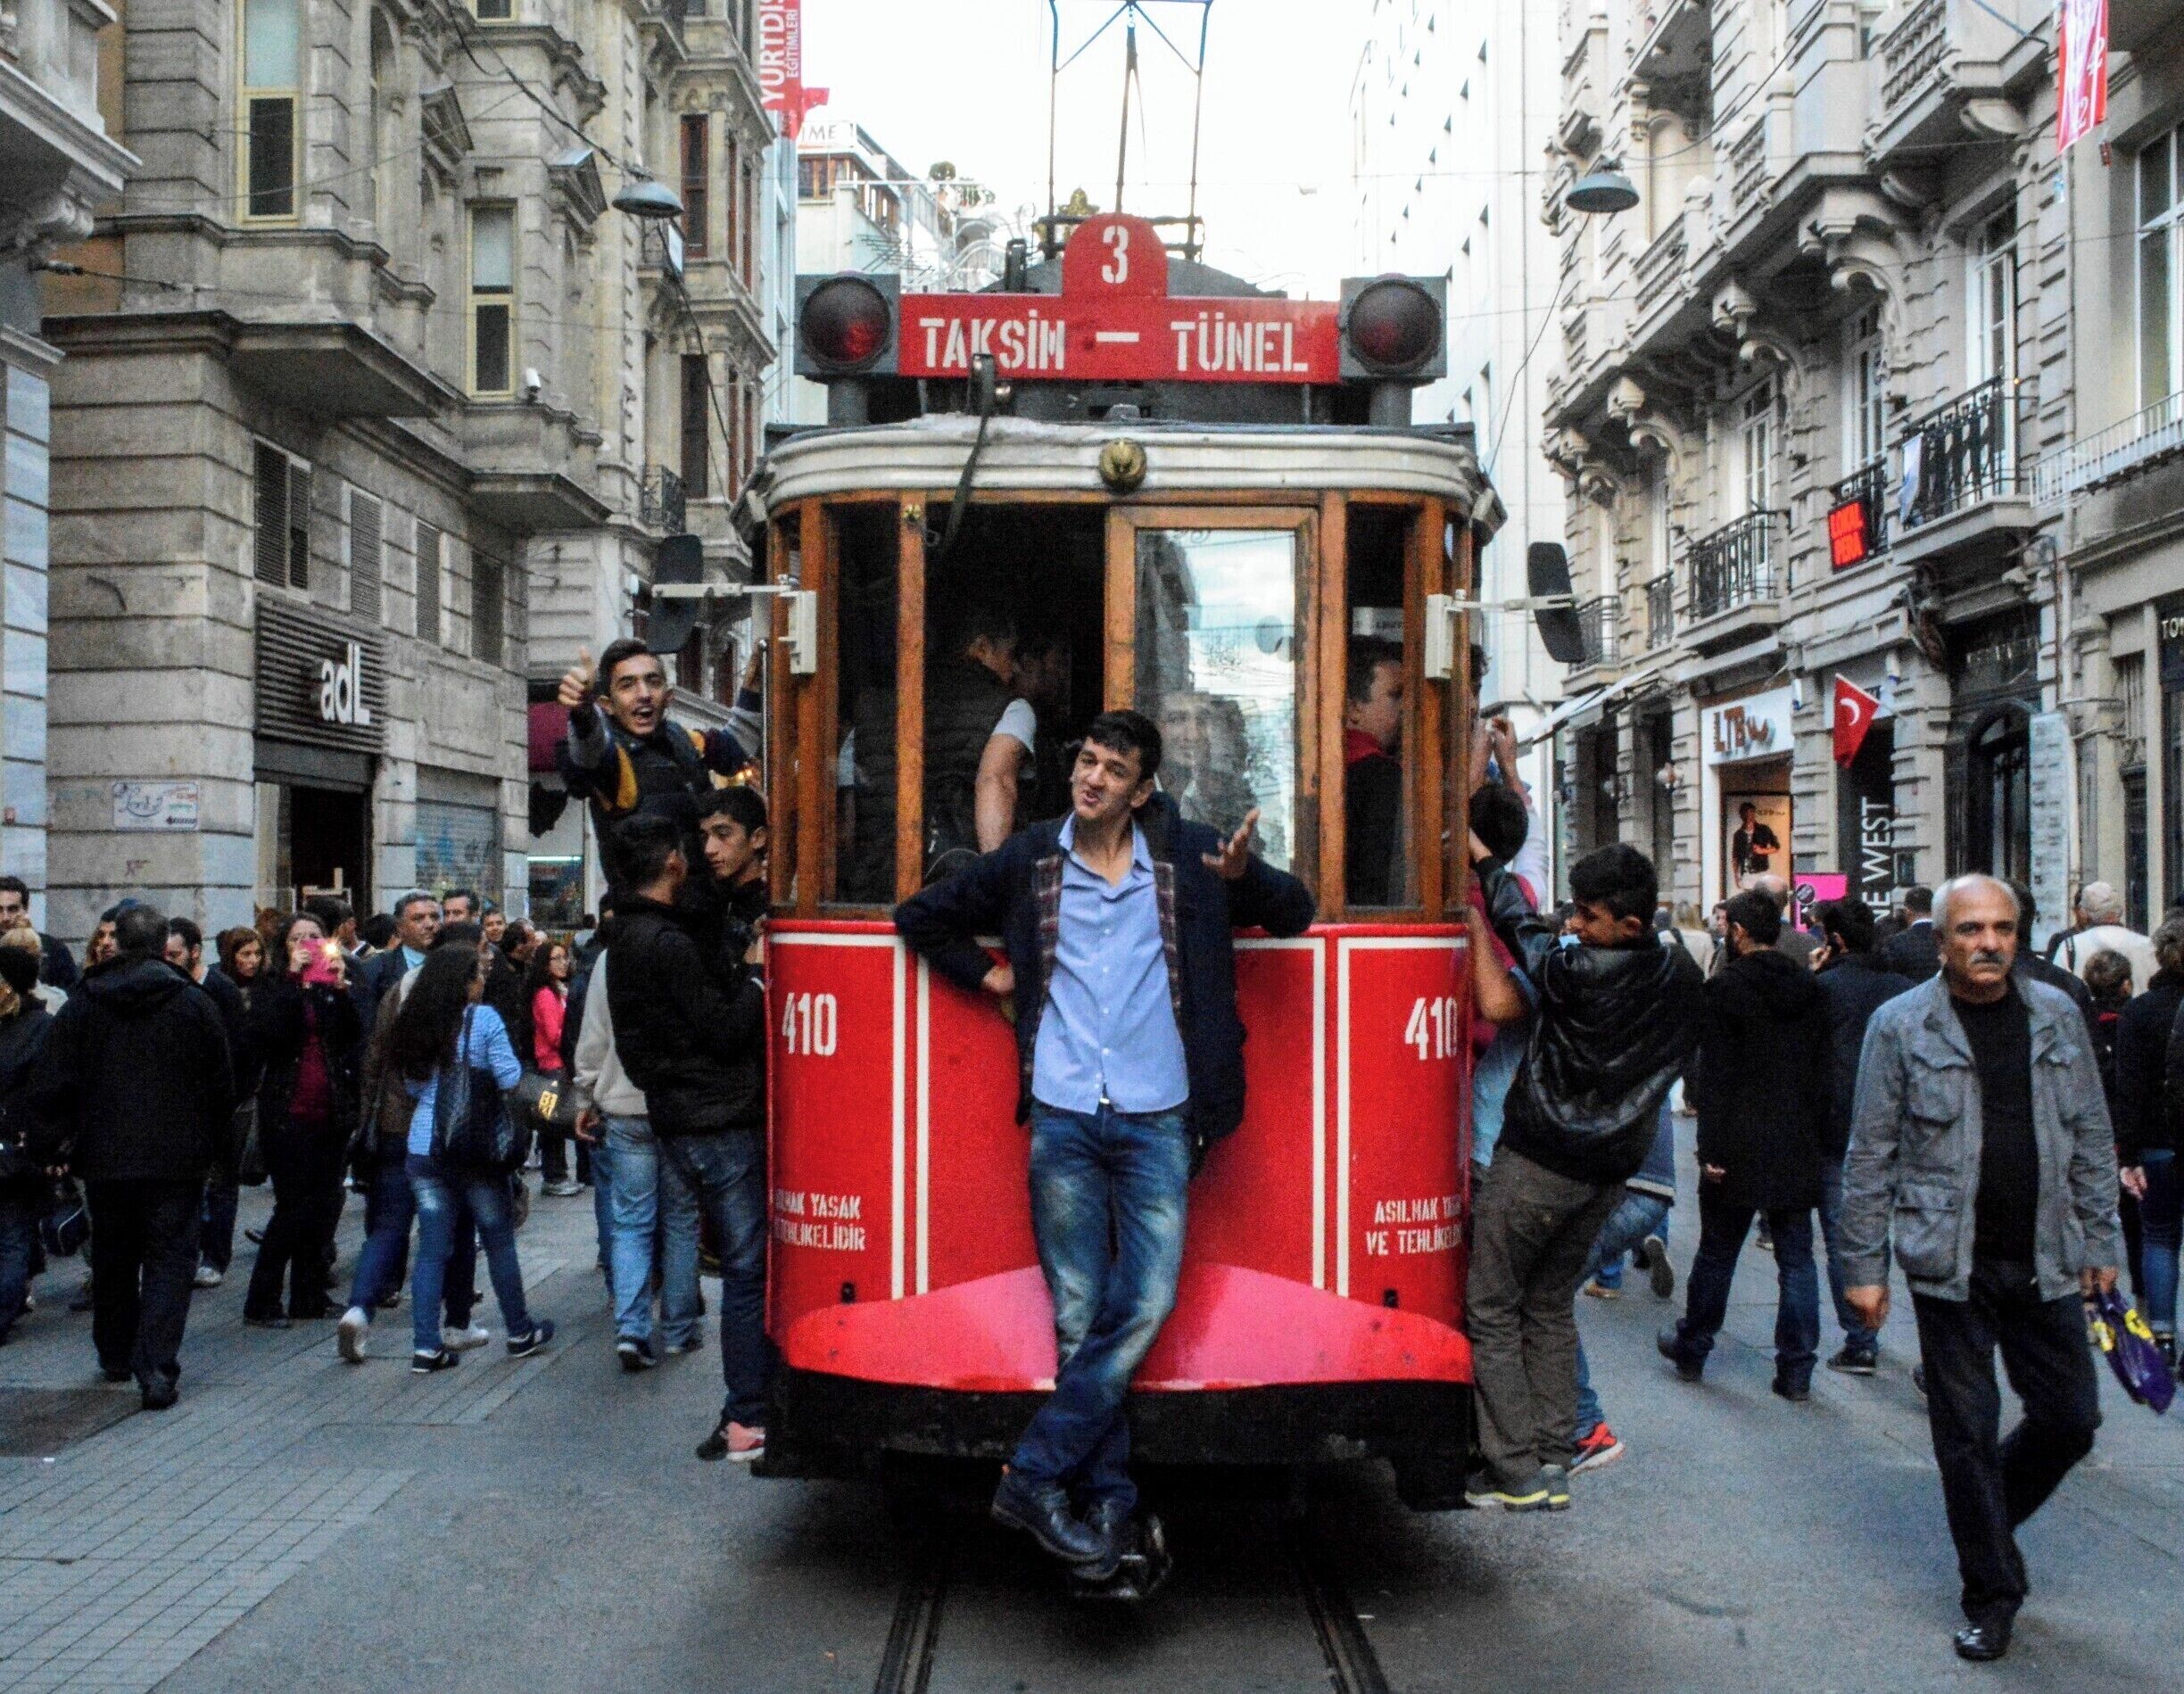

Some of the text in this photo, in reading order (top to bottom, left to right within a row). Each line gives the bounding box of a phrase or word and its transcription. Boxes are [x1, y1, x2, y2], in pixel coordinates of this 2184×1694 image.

[1102, 226, 1129, 285] 3
[920, 309, 1065, 370] TAKSİM
[1171, 312, 1309, 371] TÜNEL
[1861, 796, 1890, 883] WEST
[782, 992, 838, 1056] 410
[1405, 996, 1458, 1061] 410
[810, 1193, 862, 1219] YASAK
[1374, 1197, 1438, 1224] ASILMAK
[1366, 1231, 1389, 1256] VE
